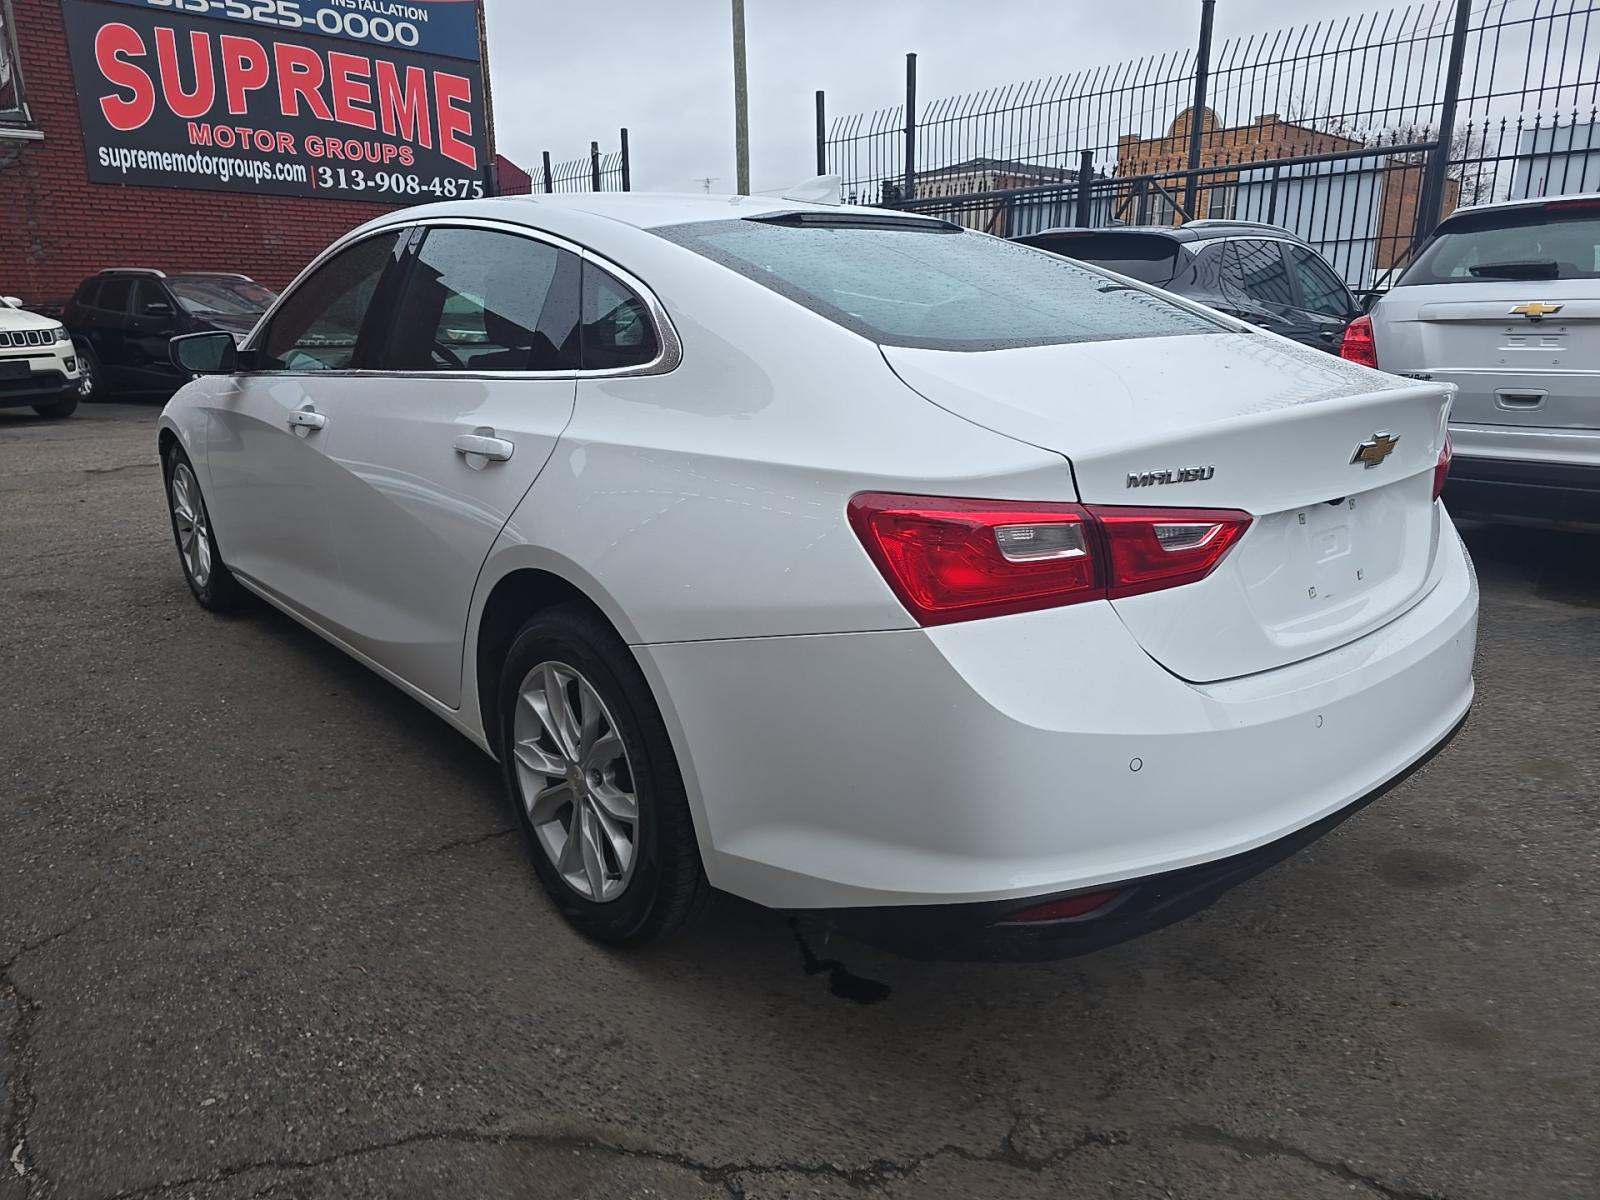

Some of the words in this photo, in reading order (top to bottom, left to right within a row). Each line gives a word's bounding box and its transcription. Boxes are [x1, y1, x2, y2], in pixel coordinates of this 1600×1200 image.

[94, 22, 477, 170] SUPREME
[187, 121, 297, 155] MOTOR
[304, 135, 415, 167] GROUPS
[98, 146, 307, 184] suprememotorgroups.com
[318, 166, 484, 199] 313-908-4875
[1126, 465, 1215, 489] MALIBU
